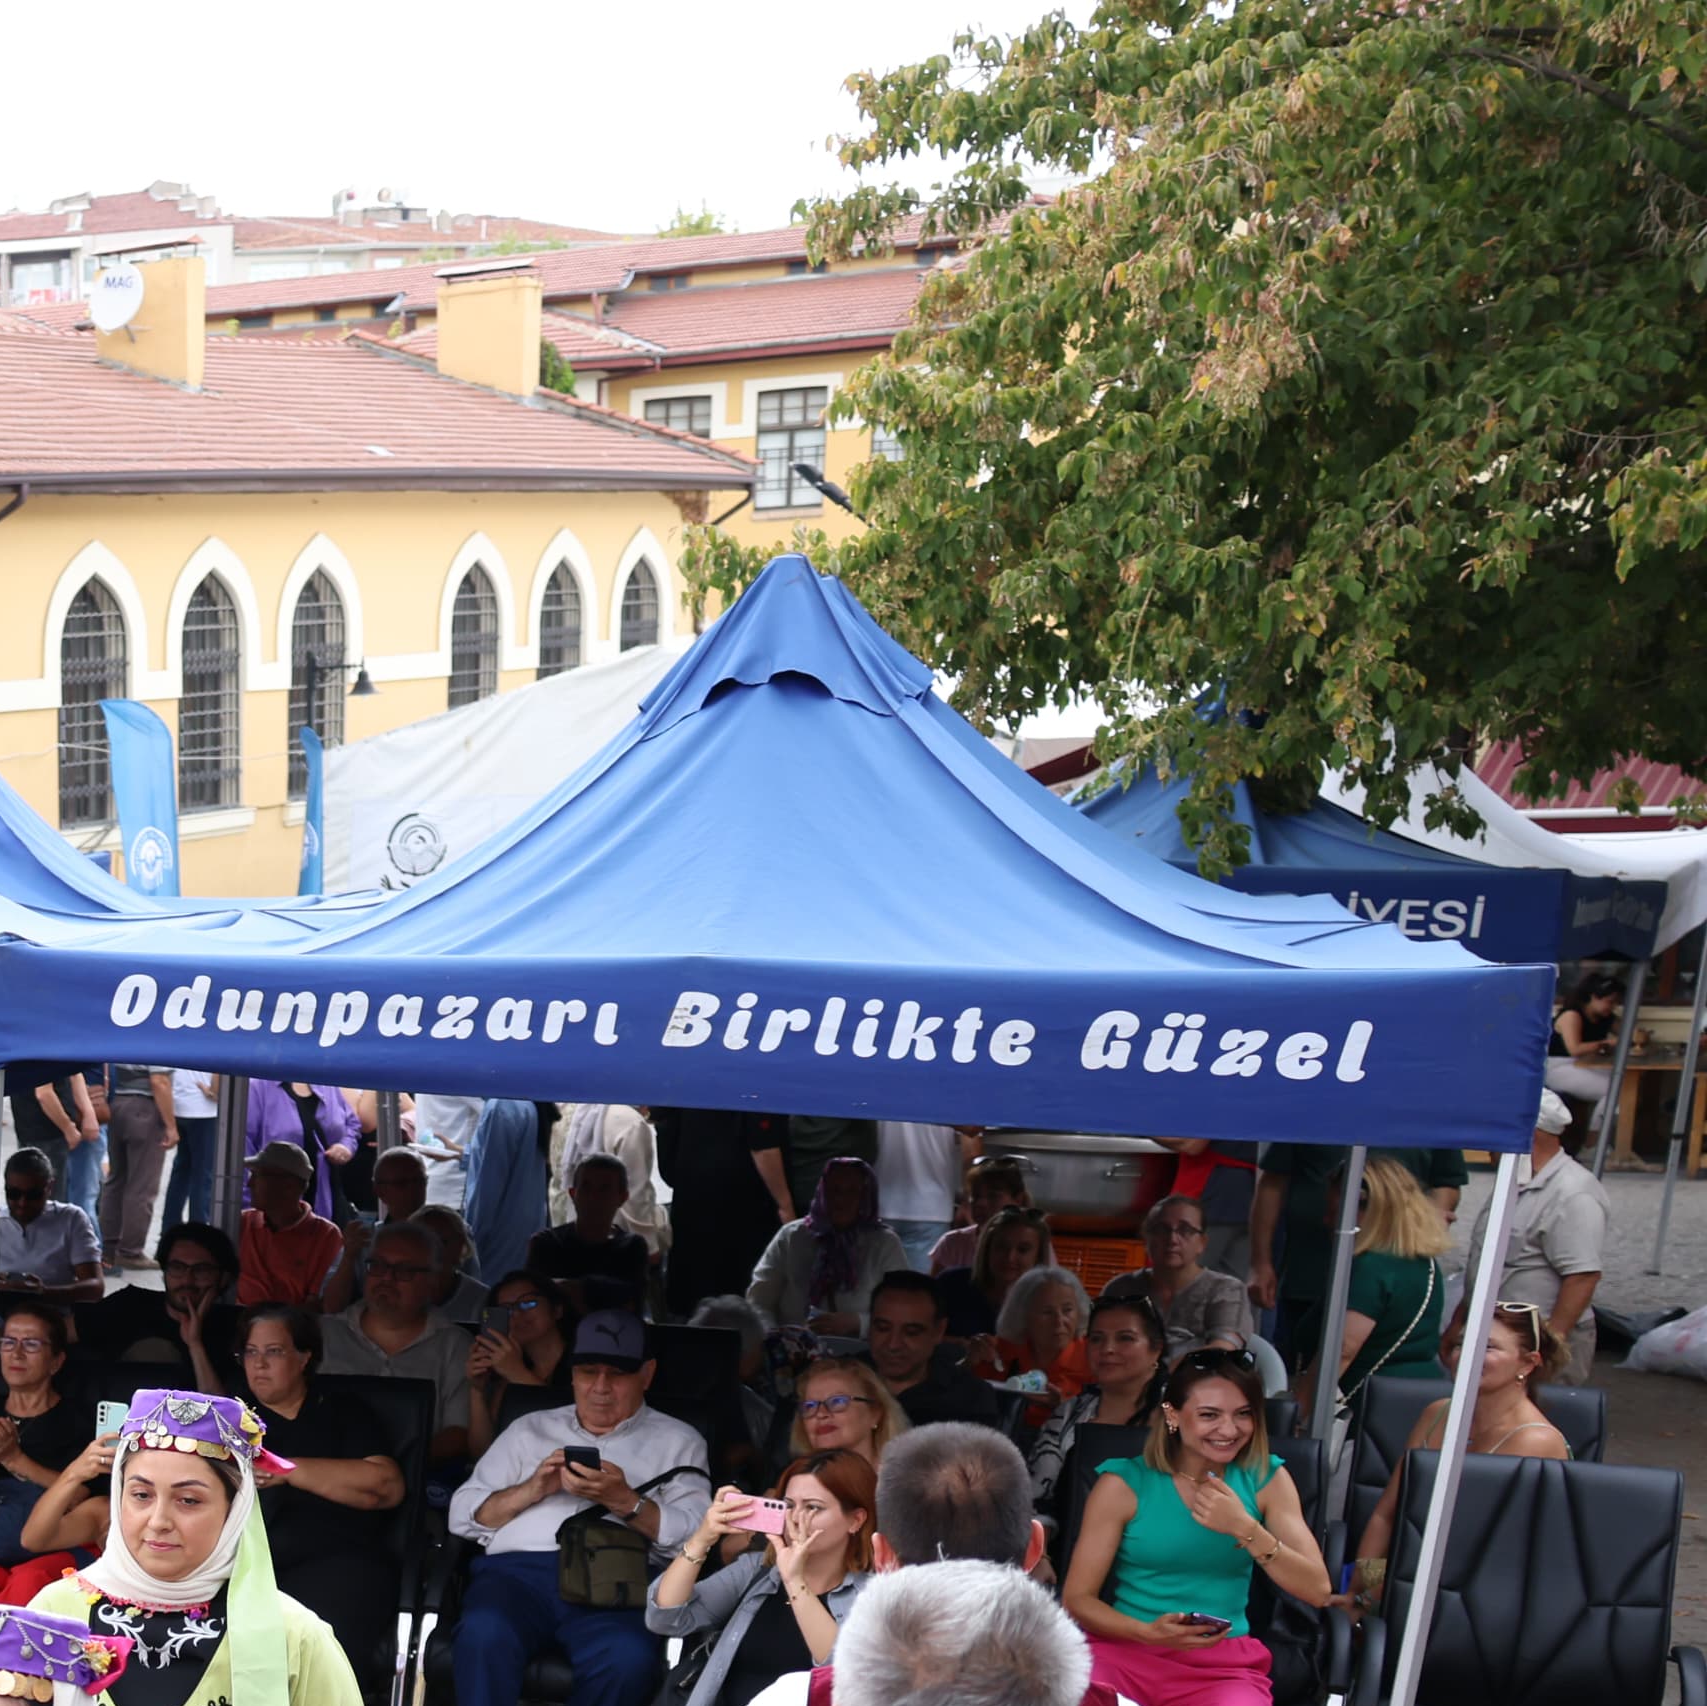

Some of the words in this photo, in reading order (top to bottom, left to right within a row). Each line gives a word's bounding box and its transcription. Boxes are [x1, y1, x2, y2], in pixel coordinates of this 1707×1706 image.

[110, 974, 619, 1049] Odunpazarı
[661, 991, 1036, 1068] Birlikte
[1080, 1010, 1373, 1083] Güzel
